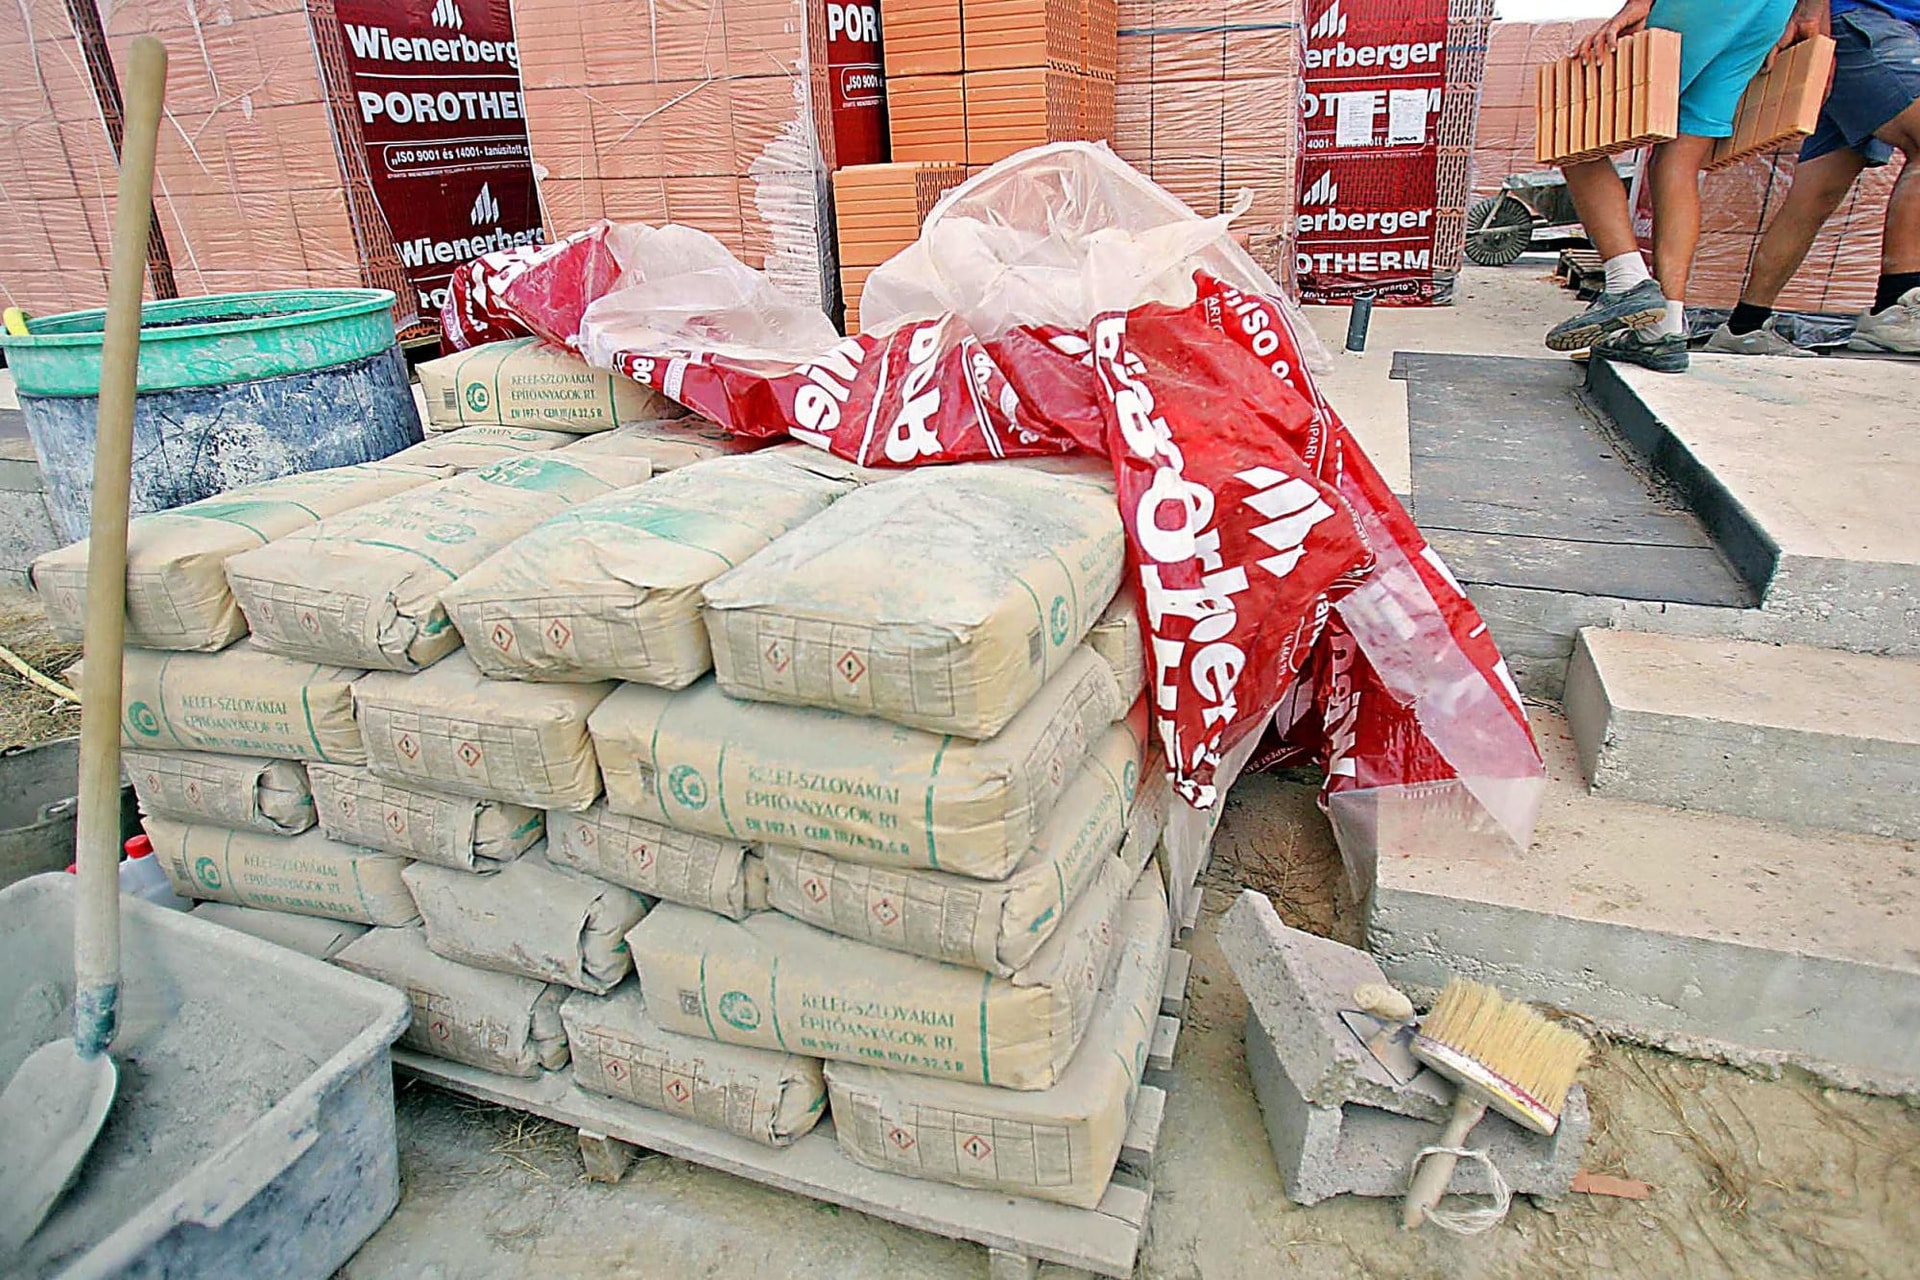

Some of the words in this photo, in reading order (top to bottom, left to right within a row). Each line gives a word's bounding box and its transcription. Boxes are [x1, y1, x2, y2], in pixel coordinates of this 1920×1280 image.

[827, 3, 881, 42] POR
[1305, 41, 1442, 70] erberger
[416, 150, 440, 161] 9001
[1297, 207, 1432, 235] erberger
[1296, 249, 1430, 275] OTHERM
